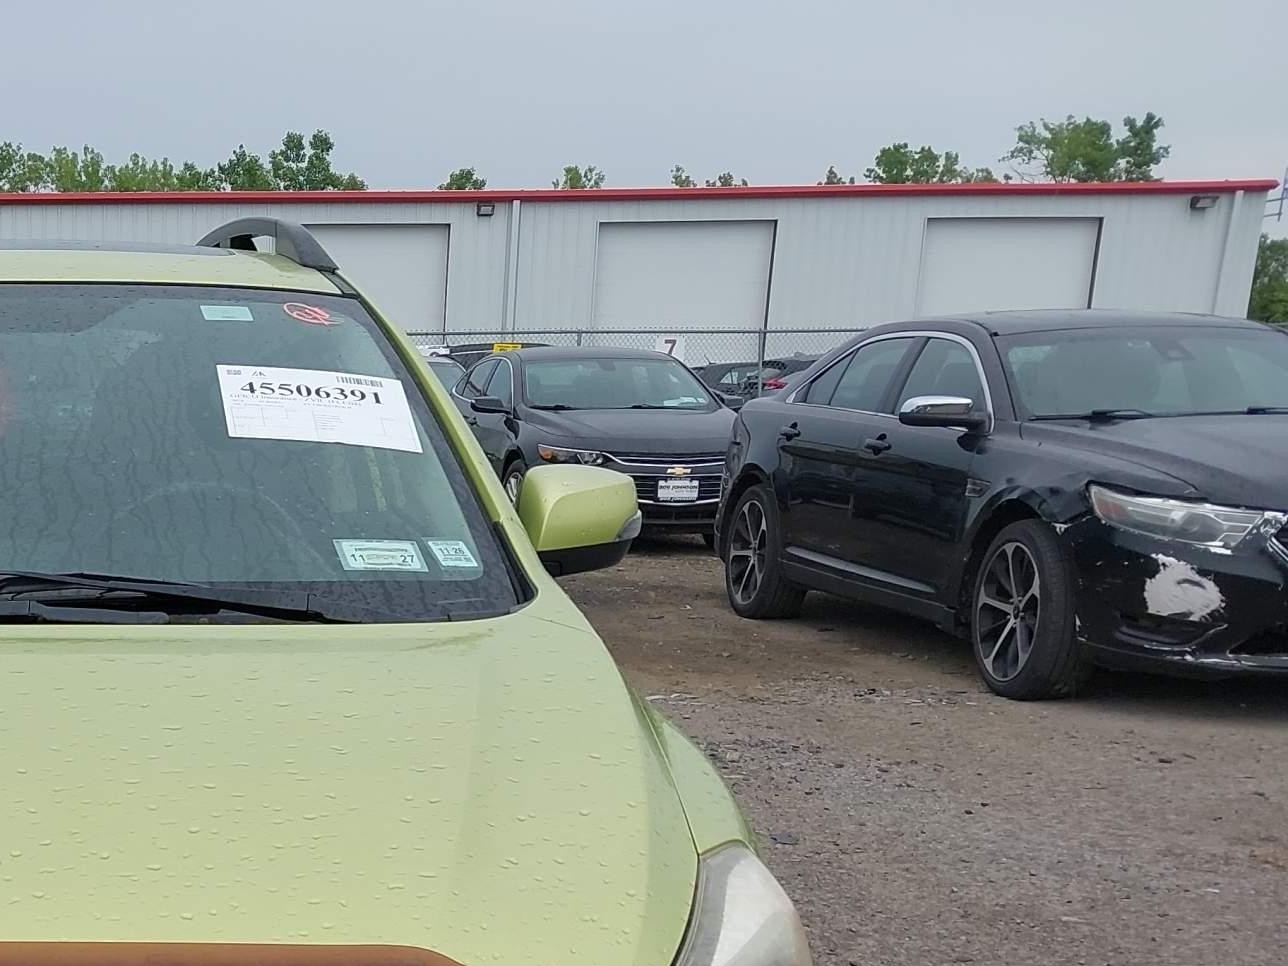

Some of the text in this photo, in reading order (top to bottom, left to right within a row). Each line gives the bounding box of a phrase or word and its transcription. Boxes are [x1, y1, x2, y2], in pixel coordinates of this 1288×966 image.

[664, 339, 678, 355] 7
[240, 381, 384, 405] 45506391
[350, 554, 414, 563] 11 27
